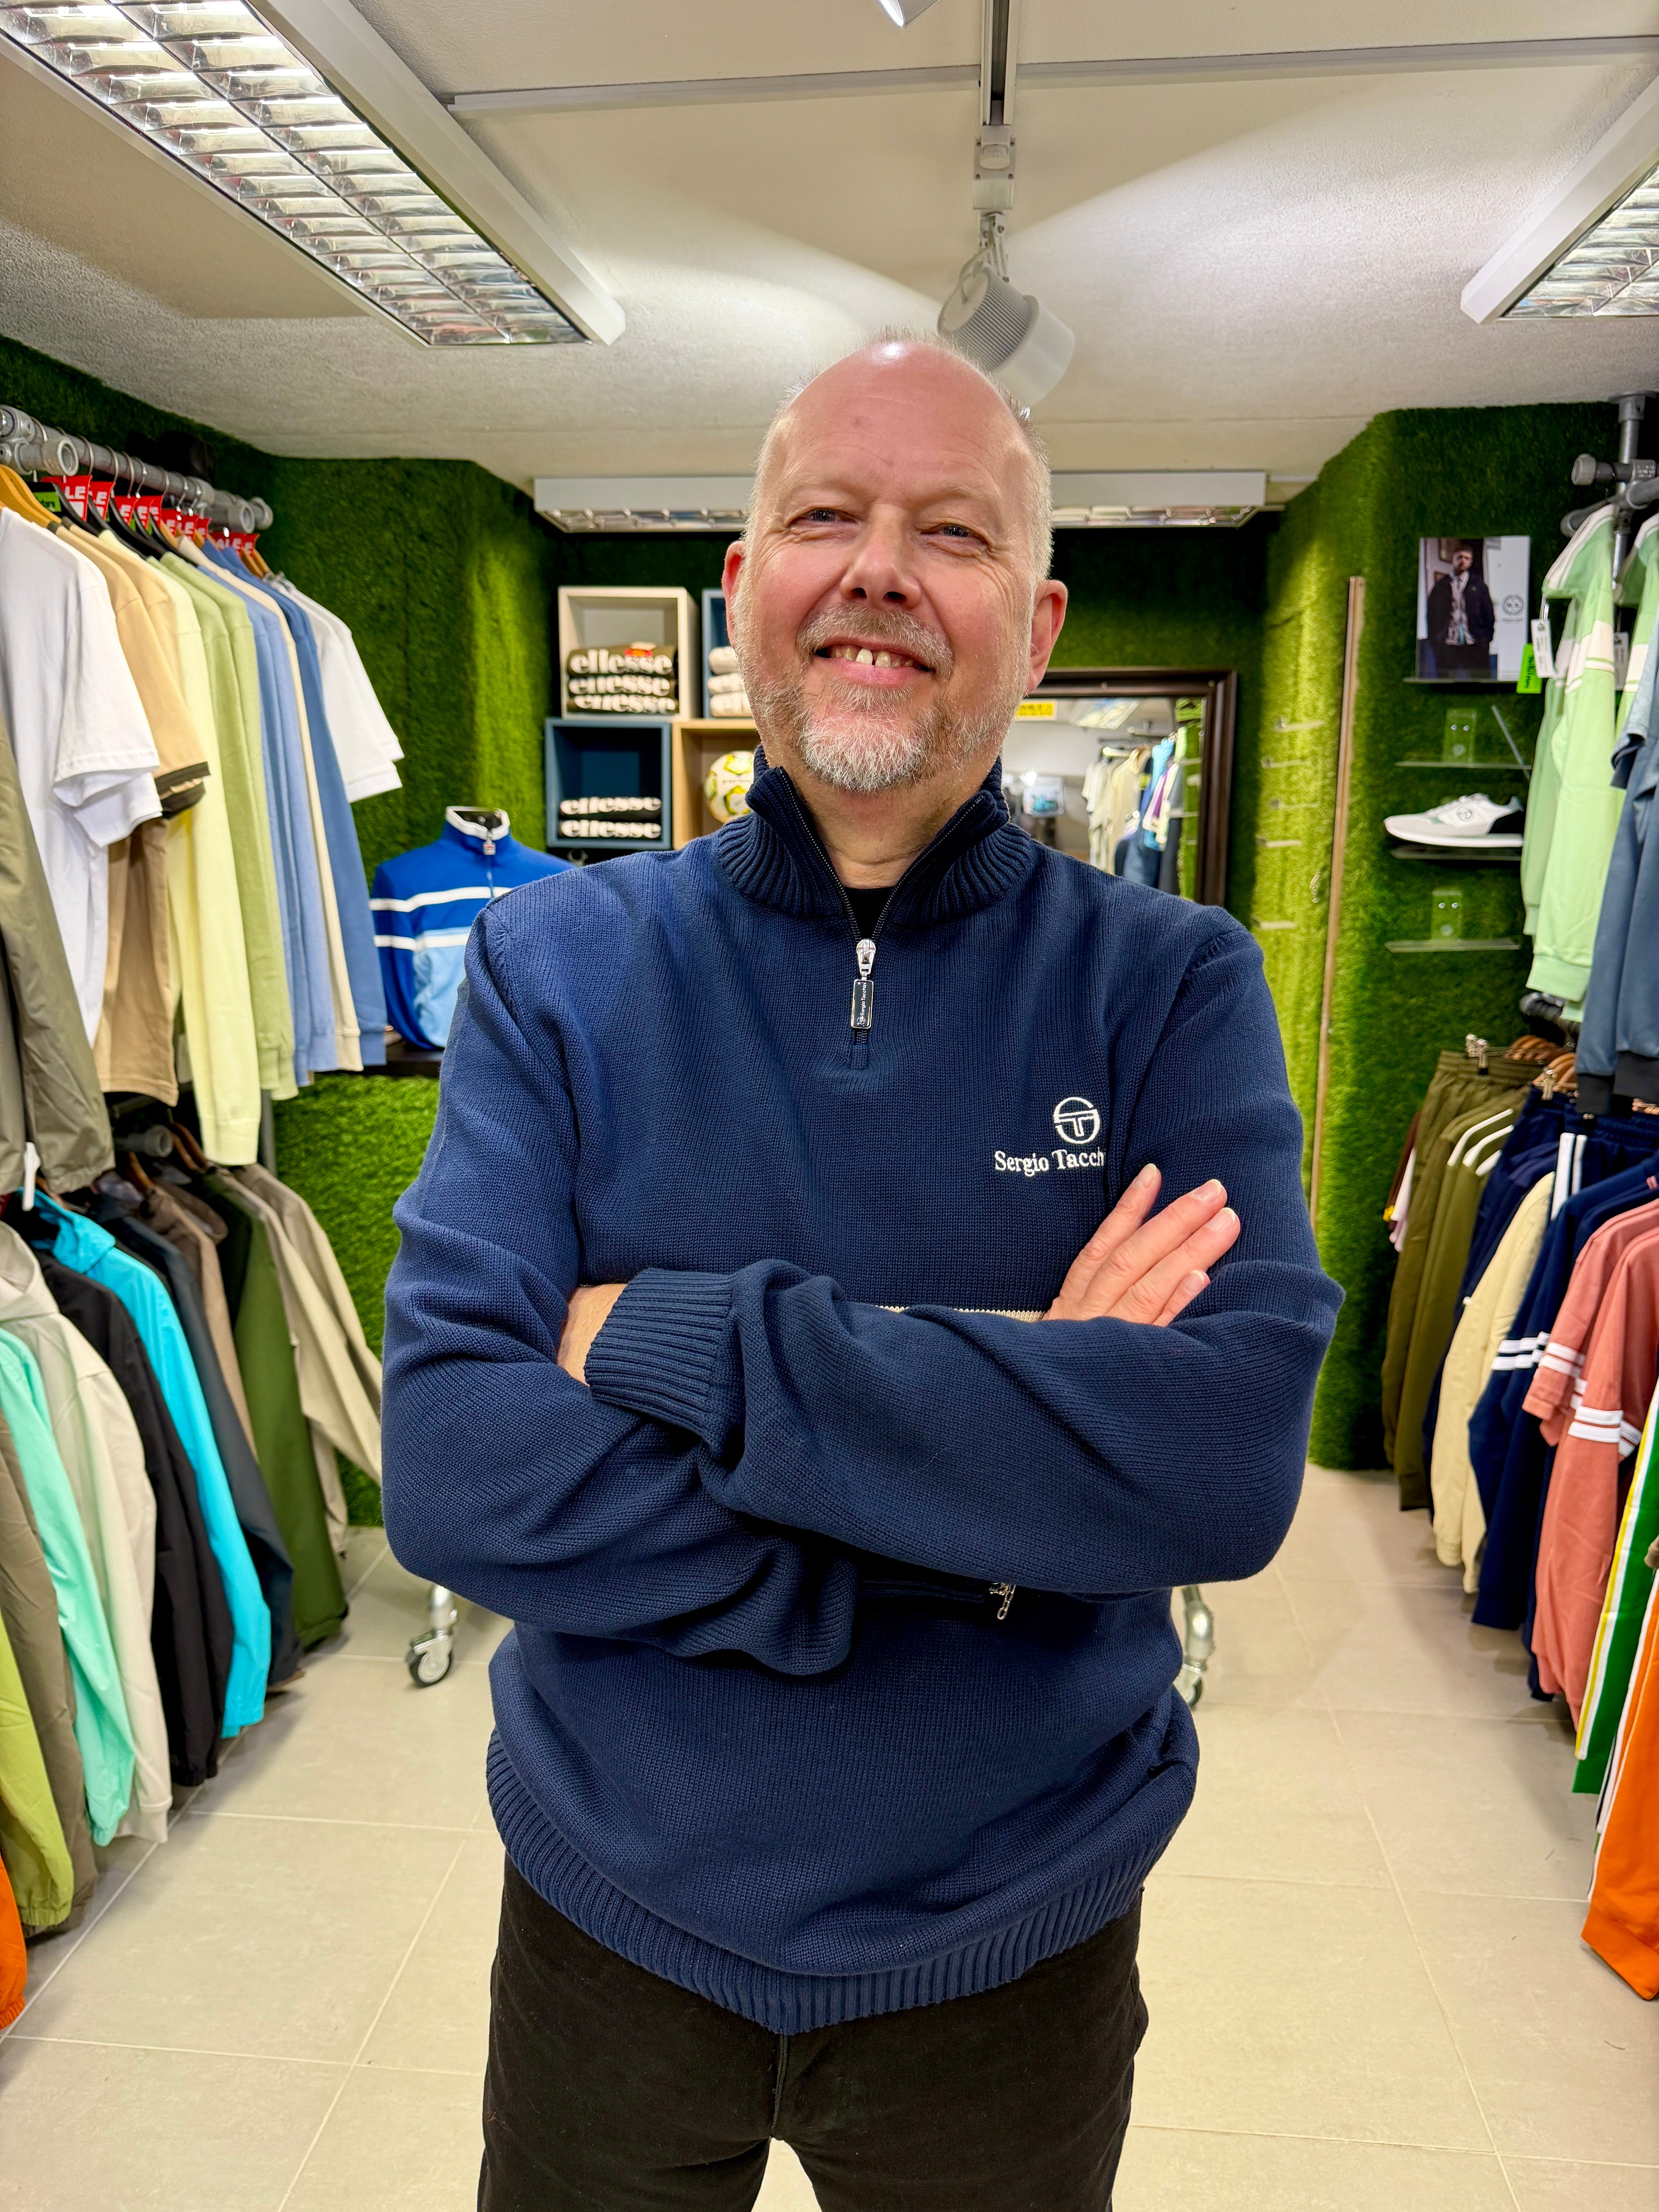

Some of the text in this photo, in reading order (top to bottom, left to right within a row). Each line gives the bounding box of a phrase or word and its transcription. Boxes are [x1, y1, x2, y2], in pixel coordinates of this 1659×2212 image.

[570, 649, 672, 675] ellesse
[560, 797, 661, 815] ellesse
[561, 819, 661, 838] ellesse
[994, 1147, 1105, 1177] Sergio Tacch
